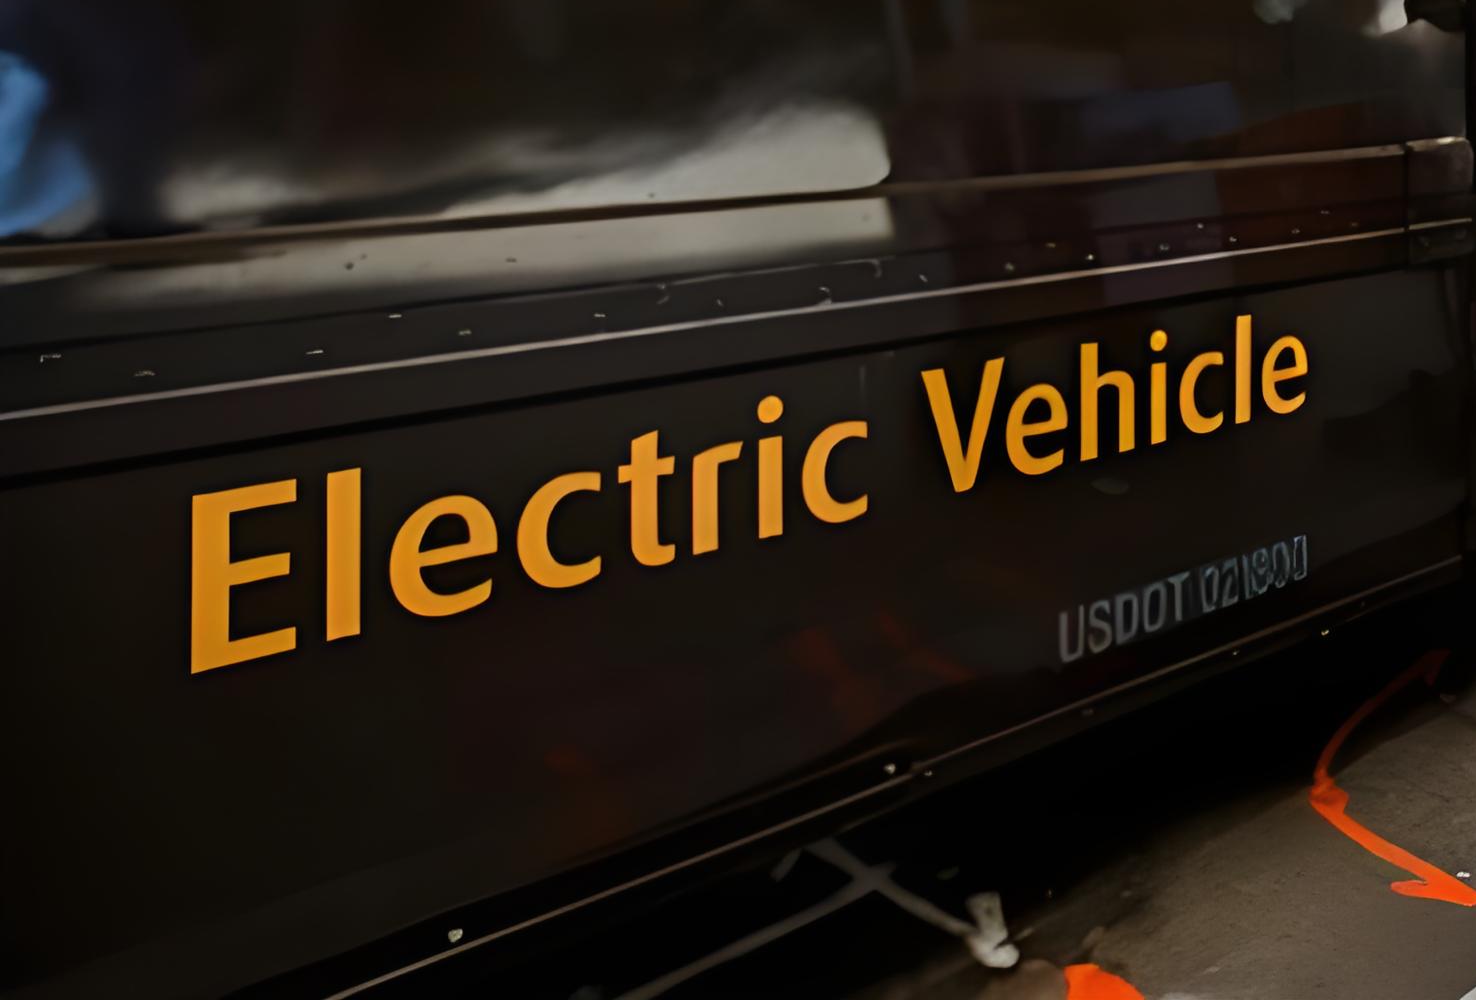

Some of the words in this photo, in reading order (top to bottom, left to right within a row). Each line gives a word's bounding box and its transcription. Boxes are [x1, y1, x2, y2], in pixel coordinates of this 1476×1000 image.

[190, 395, 870, 674] Electric
[921, 314, 1310, 493] Vehicle
[1059, 571, 1190, 663] USDOT
